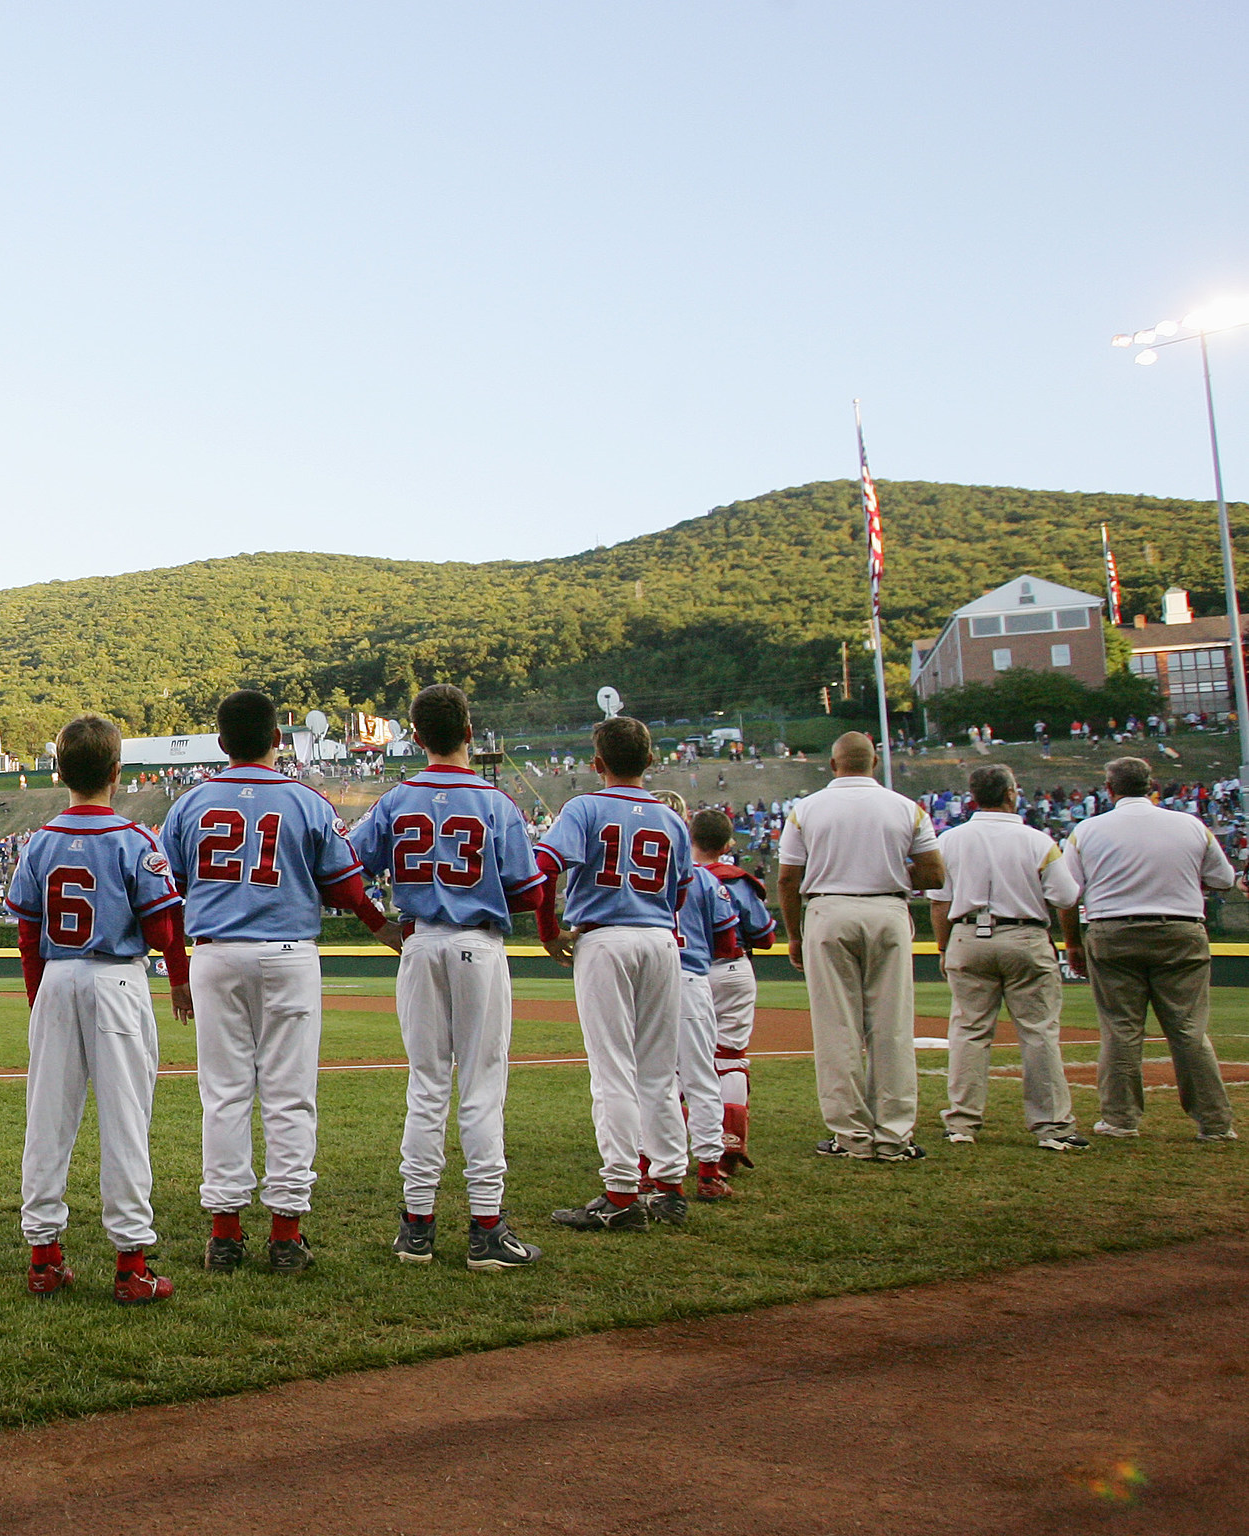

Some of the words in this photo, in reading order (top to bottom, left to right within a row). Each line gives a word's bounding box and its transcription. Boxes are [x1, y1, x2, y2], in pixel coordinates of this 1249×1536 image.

[197, 807, 282, 888] 21
[392, 812, 487, 889] 23
[595, 823, 672, 895] 19
[46, 865, 96, 948] 6
[461, 950, 472, 963] R
